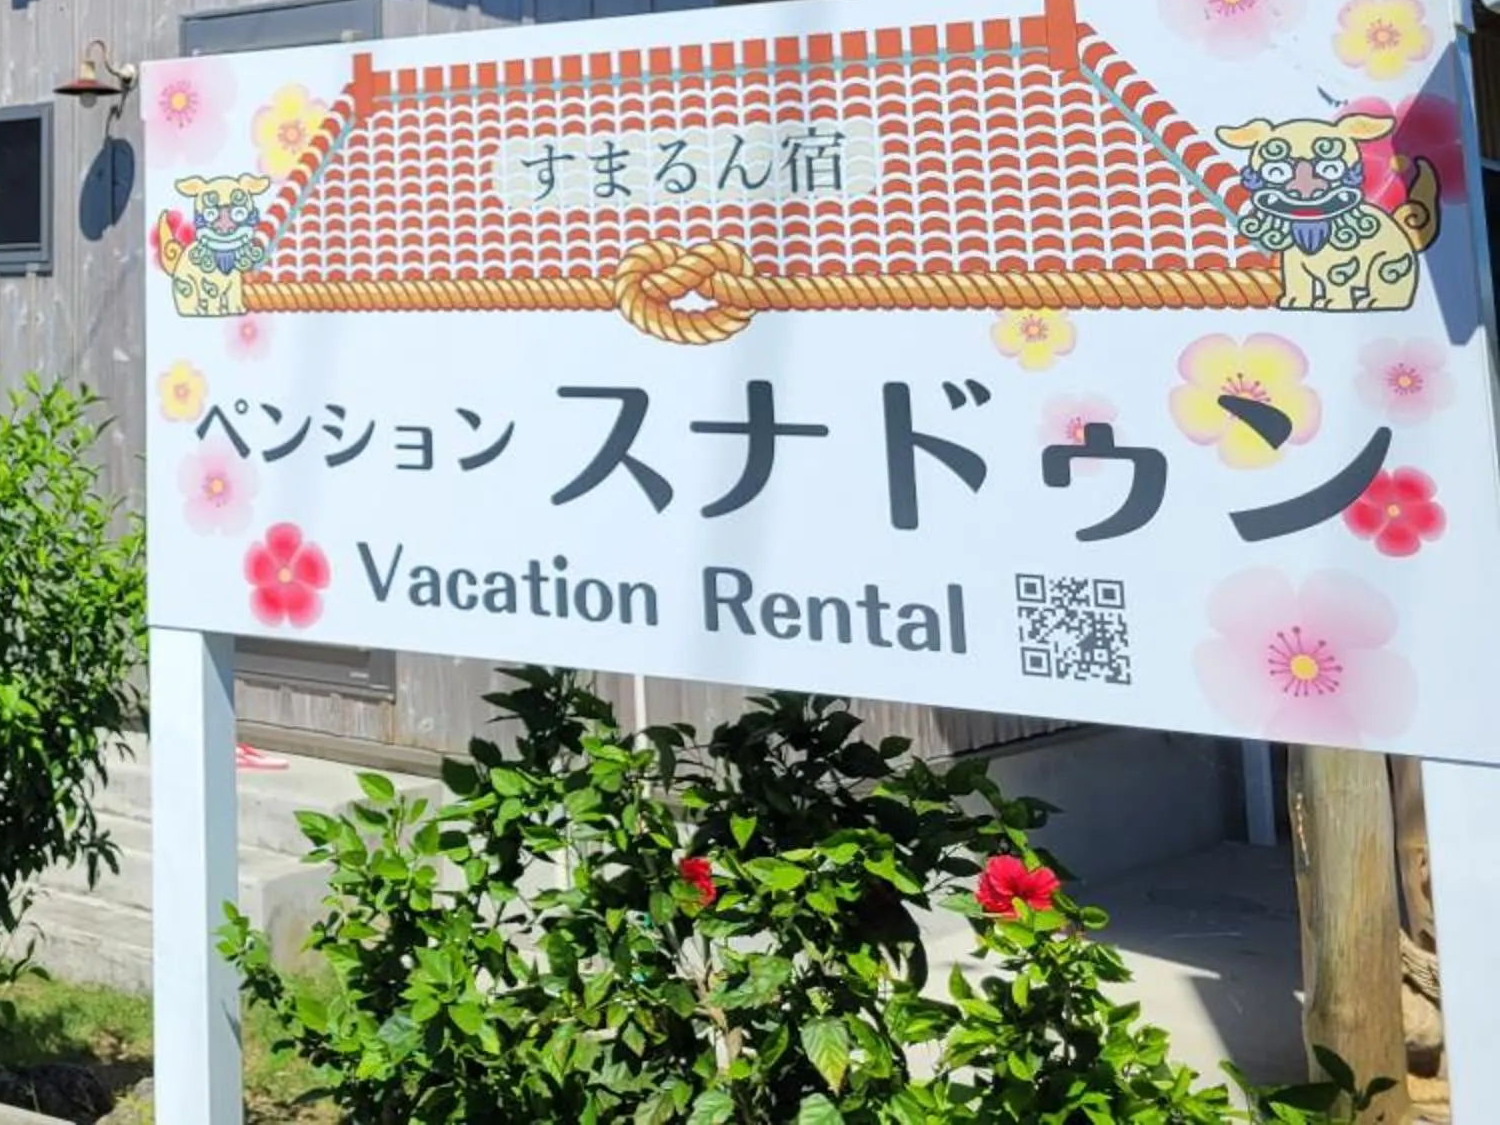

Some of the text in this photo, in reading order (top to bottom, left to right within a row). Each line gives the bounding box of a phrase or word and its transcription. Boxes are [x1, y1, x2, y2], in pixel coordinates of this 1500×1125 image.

[520, 126, 846, 201] すまるん宿
[197, 378, 1392, 543] ペンション スナドゥン
[357, 541, 968, 655] Vacation Rental
